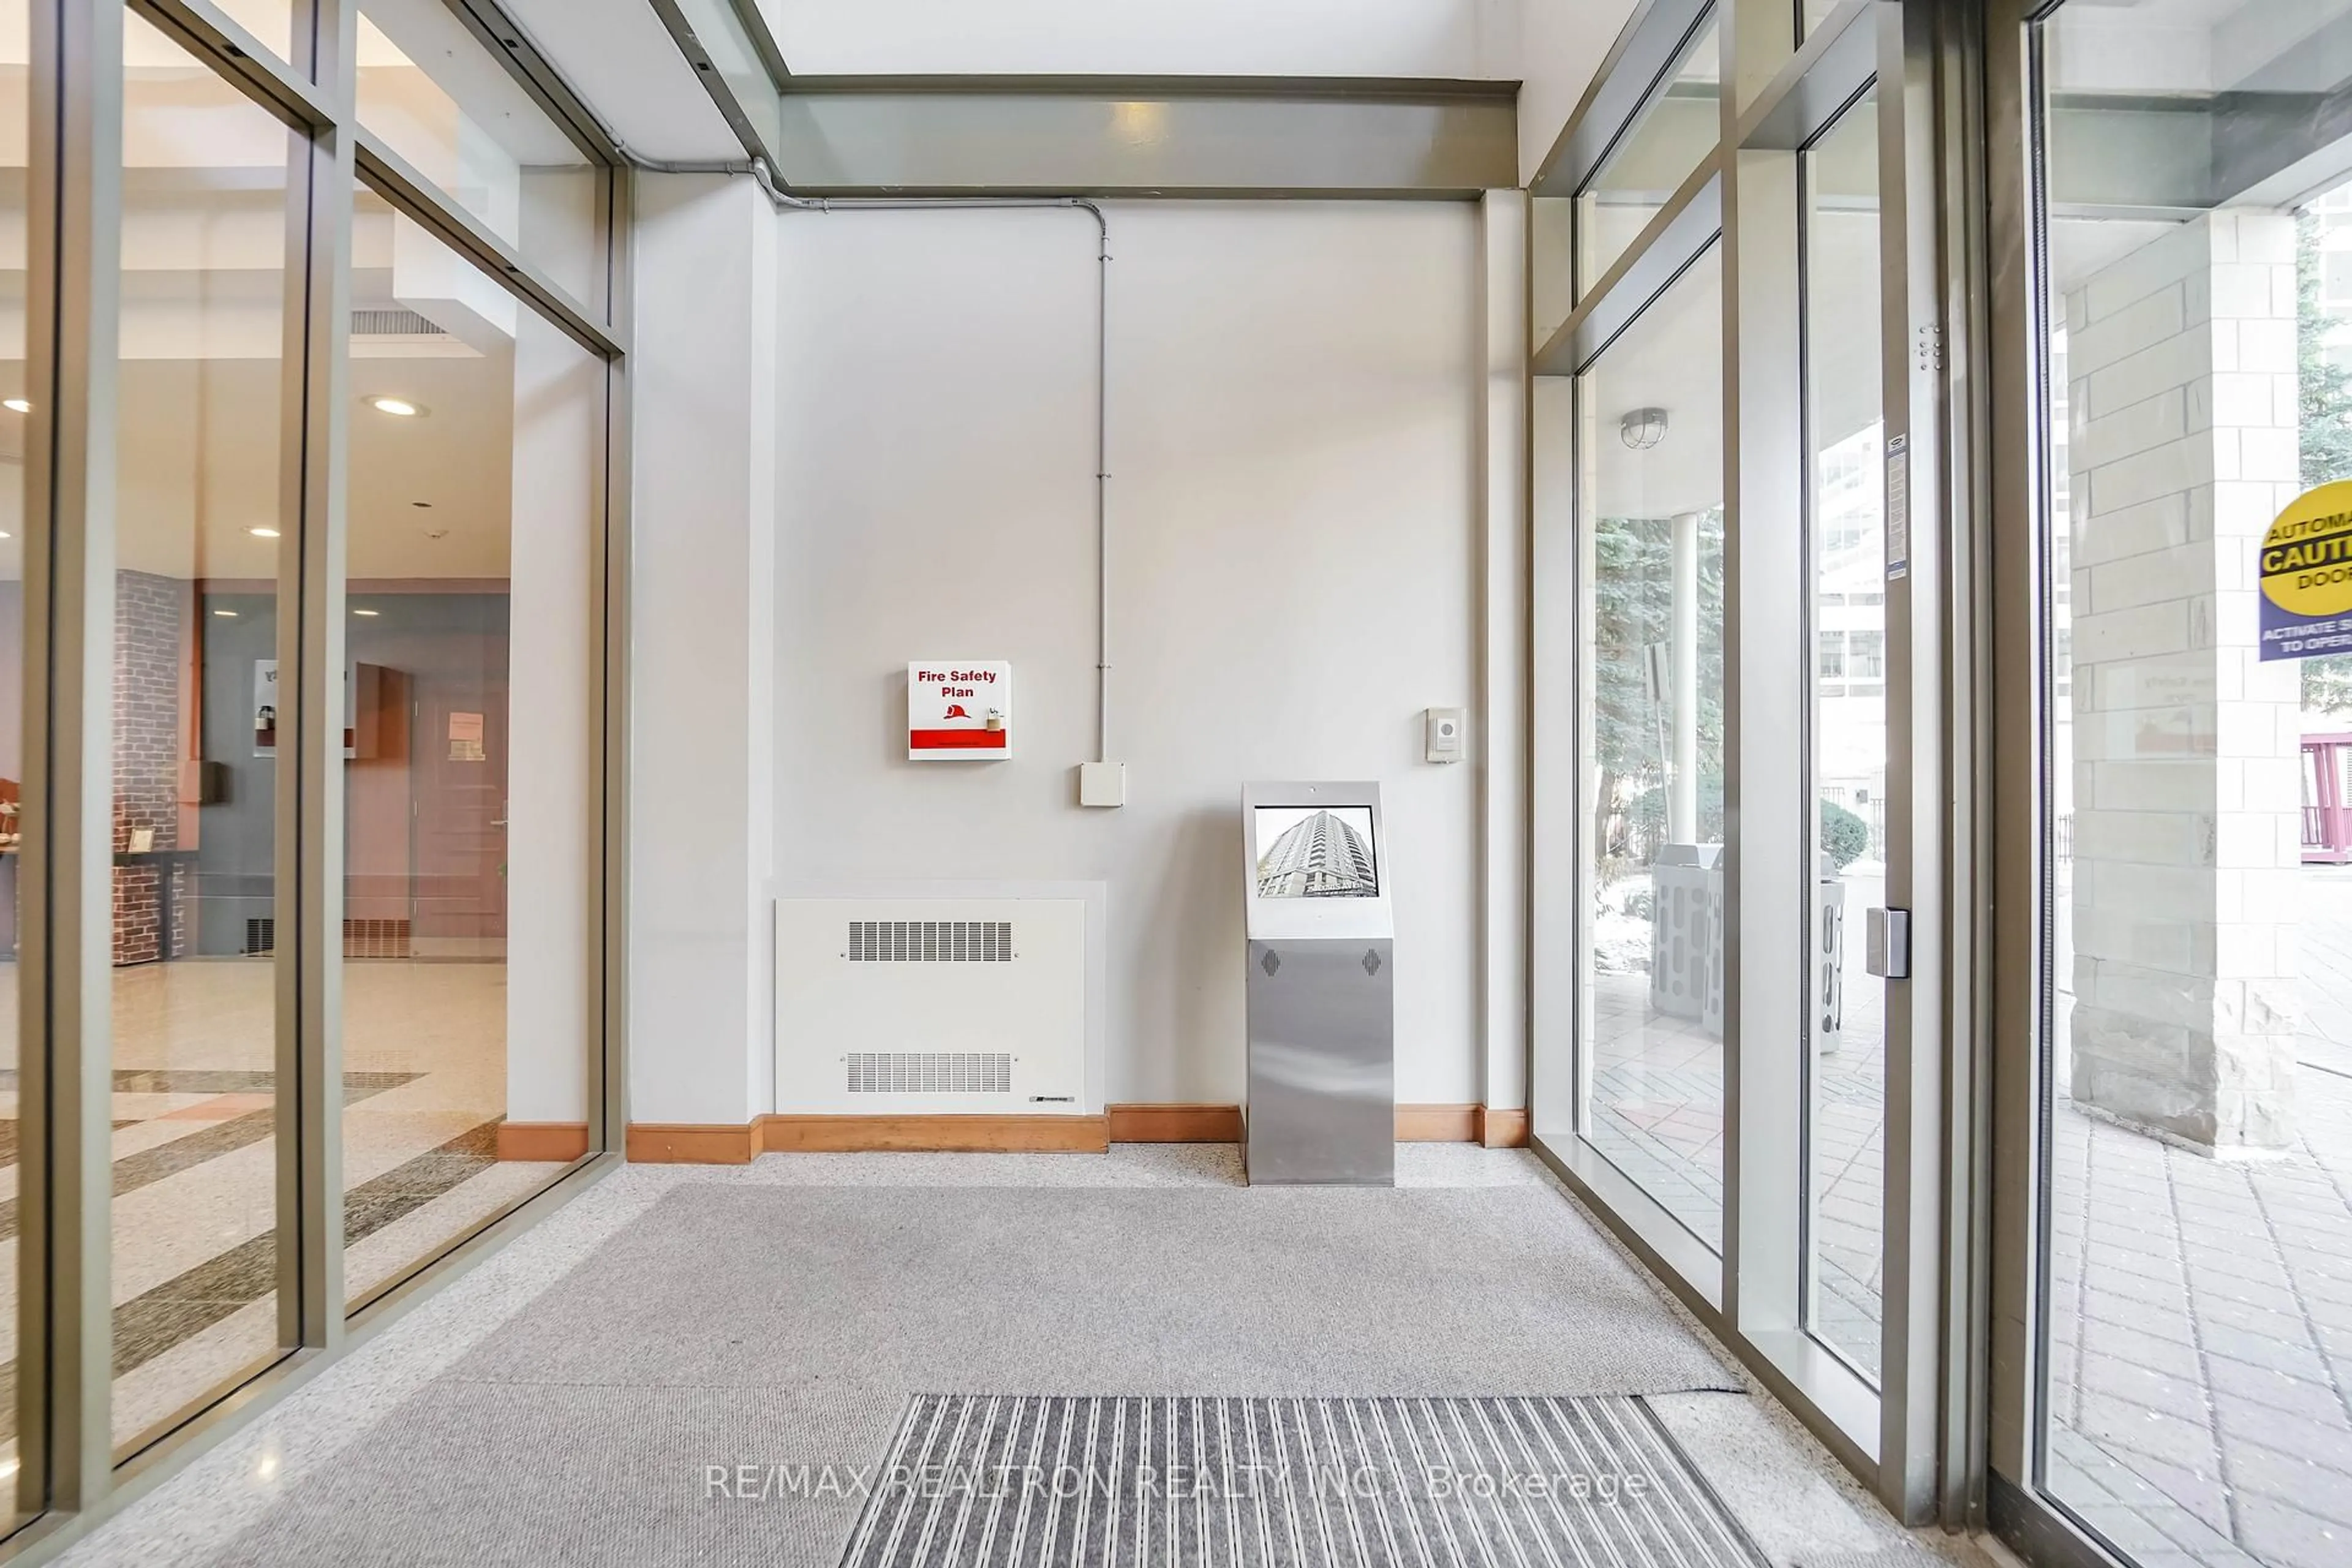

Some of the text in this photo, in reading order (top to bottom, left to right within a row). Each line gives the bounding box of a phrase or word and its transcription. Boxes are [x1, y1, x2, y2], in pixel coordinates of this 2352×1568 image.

[2261, 620, 2337, 641] ACTIVATE
[2280, 640, 2303, 652] TO
[919, 670, 997, 684] Fire Safety
[942, 687, 974, 697] Plan
